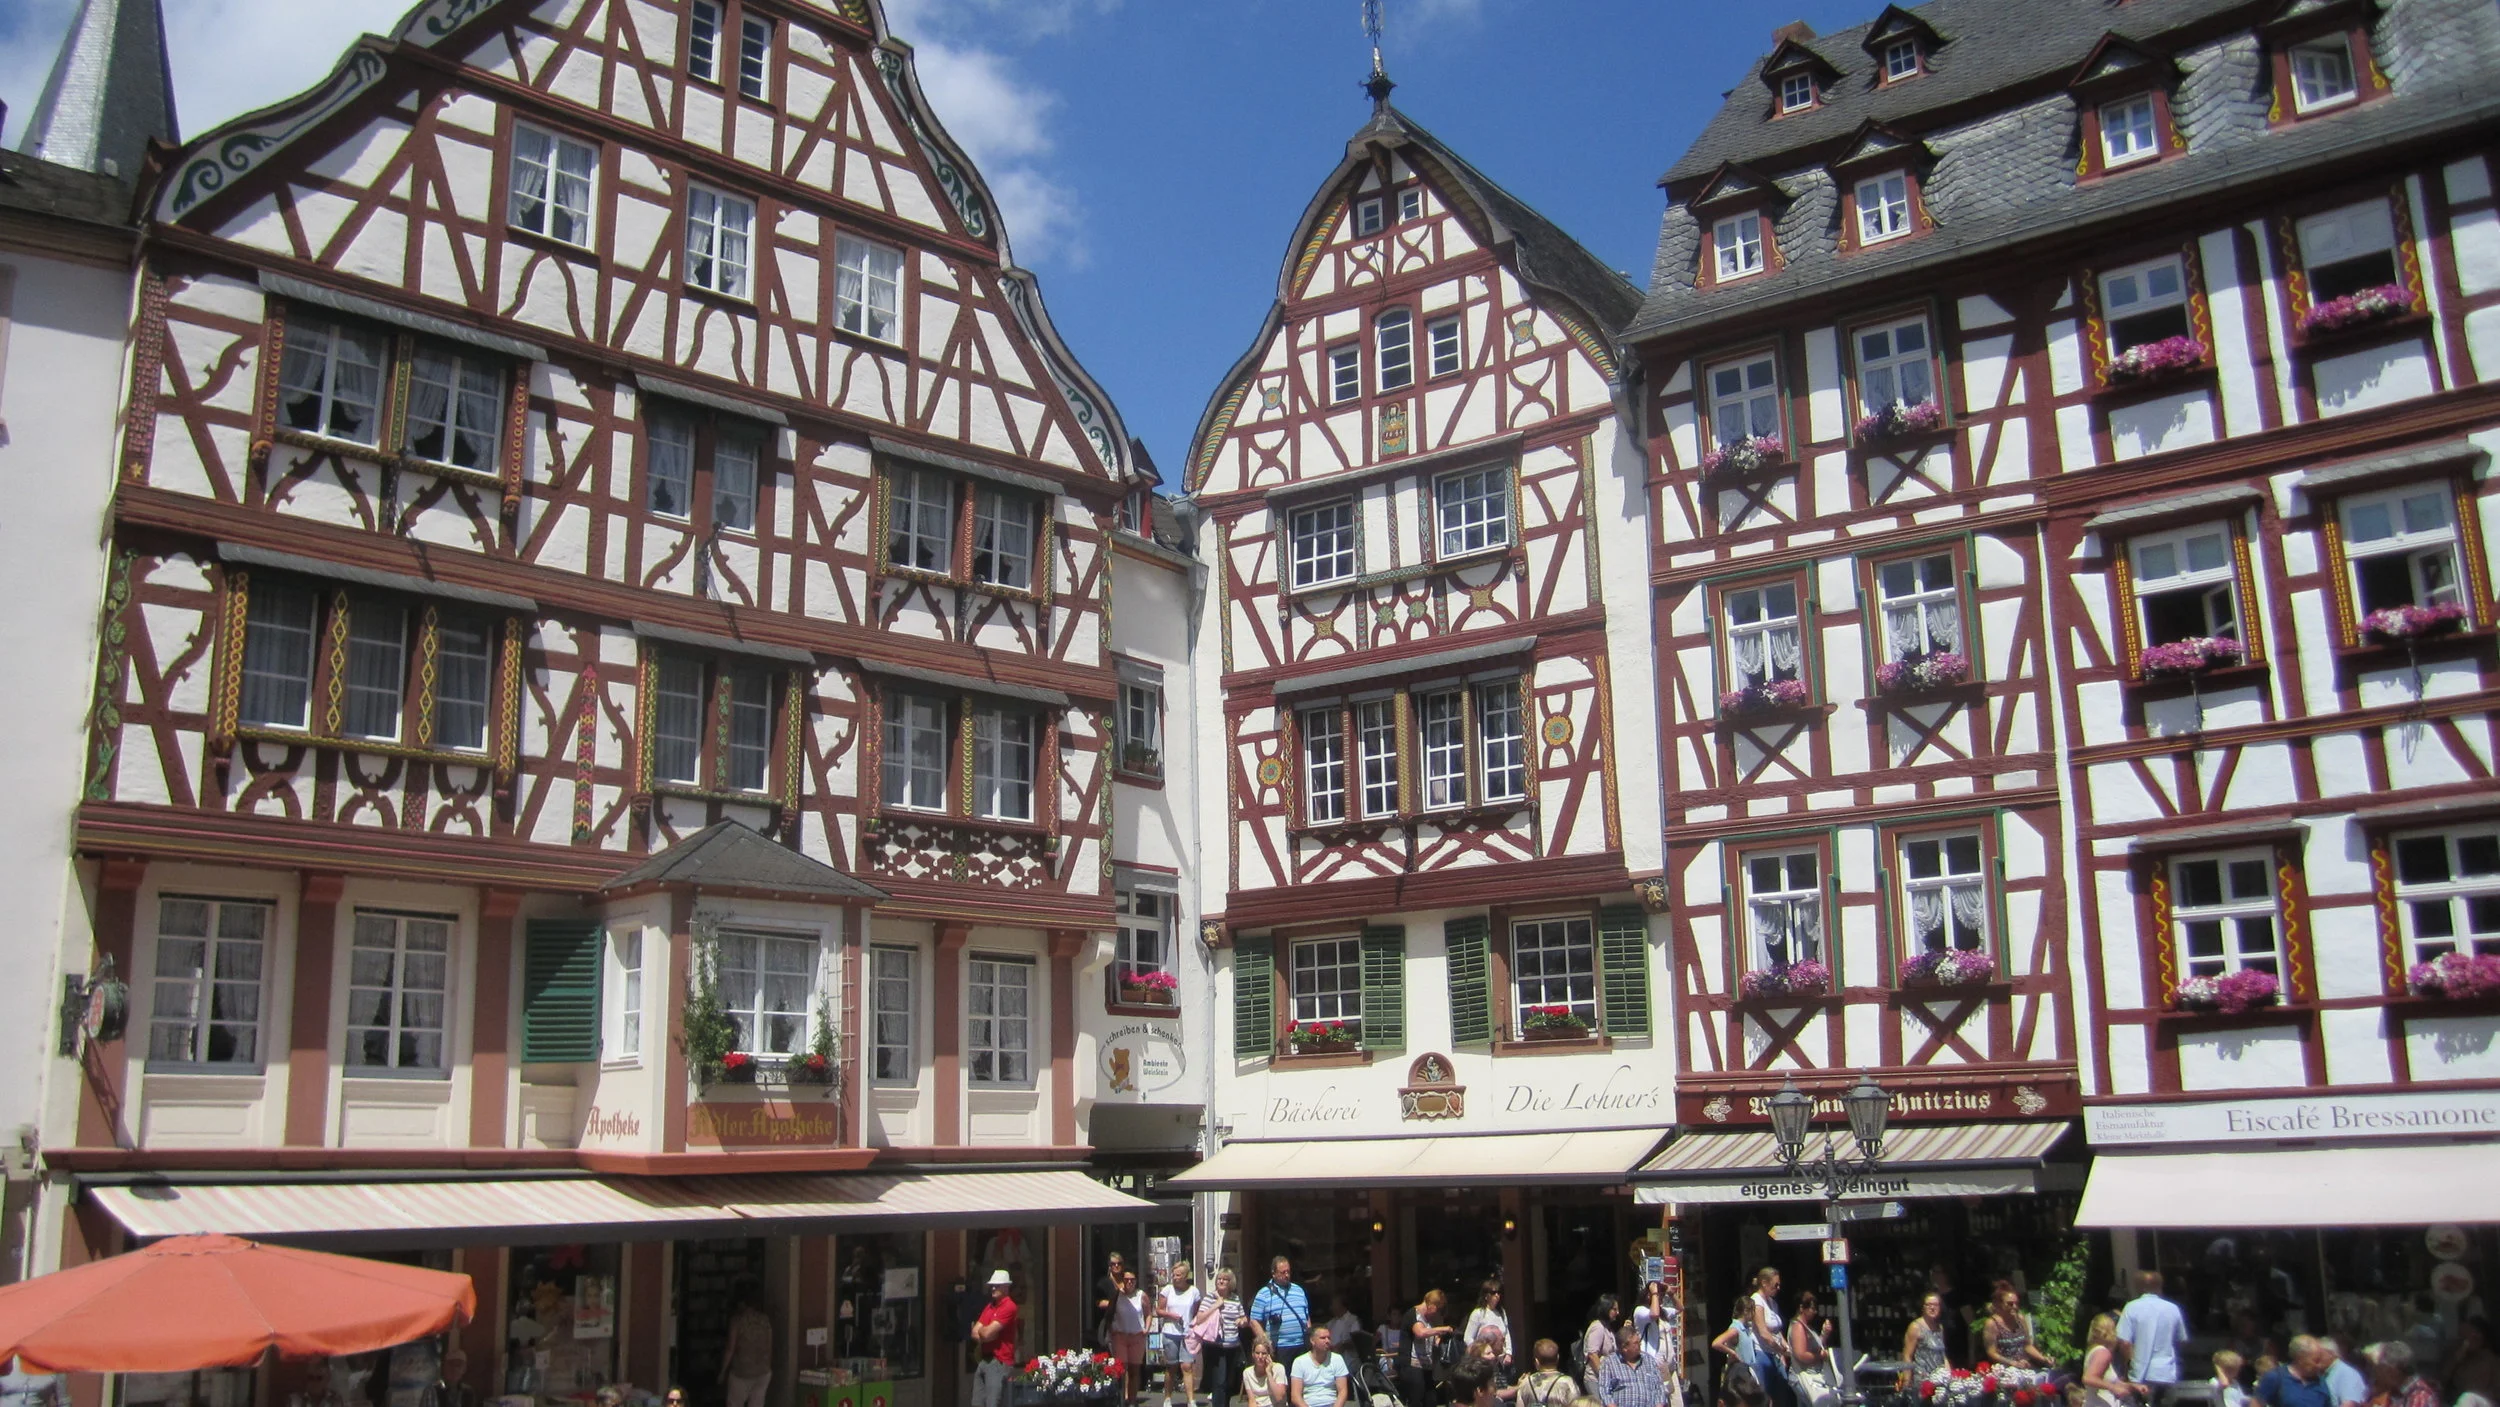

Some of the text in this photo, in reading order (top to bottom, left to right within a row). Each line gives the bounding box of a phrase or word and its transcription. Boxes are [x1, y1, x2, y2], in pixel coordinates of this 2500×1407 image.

[1105, 1023, 1182, 1049] schreiben & schenken
[1269, 1085, 1360, 1122] Bäckerei
[1505, 1085, 1551, 1112] Die
[1886, 1090, 1991, 1116] chnitzius
[587, 1106, 639, 1142] Apotheke
[690, 1107, 833, 1141] Adler Apotheke
[2095, 1119, 2165, 1130] Eismanufaktur
[2101, 1108, 2156, 1119] Italienische
[2227, 1103, 2496, 1132] Eiscafé Bressanone
[1740, 1182, 1813, 1199] eigenes
